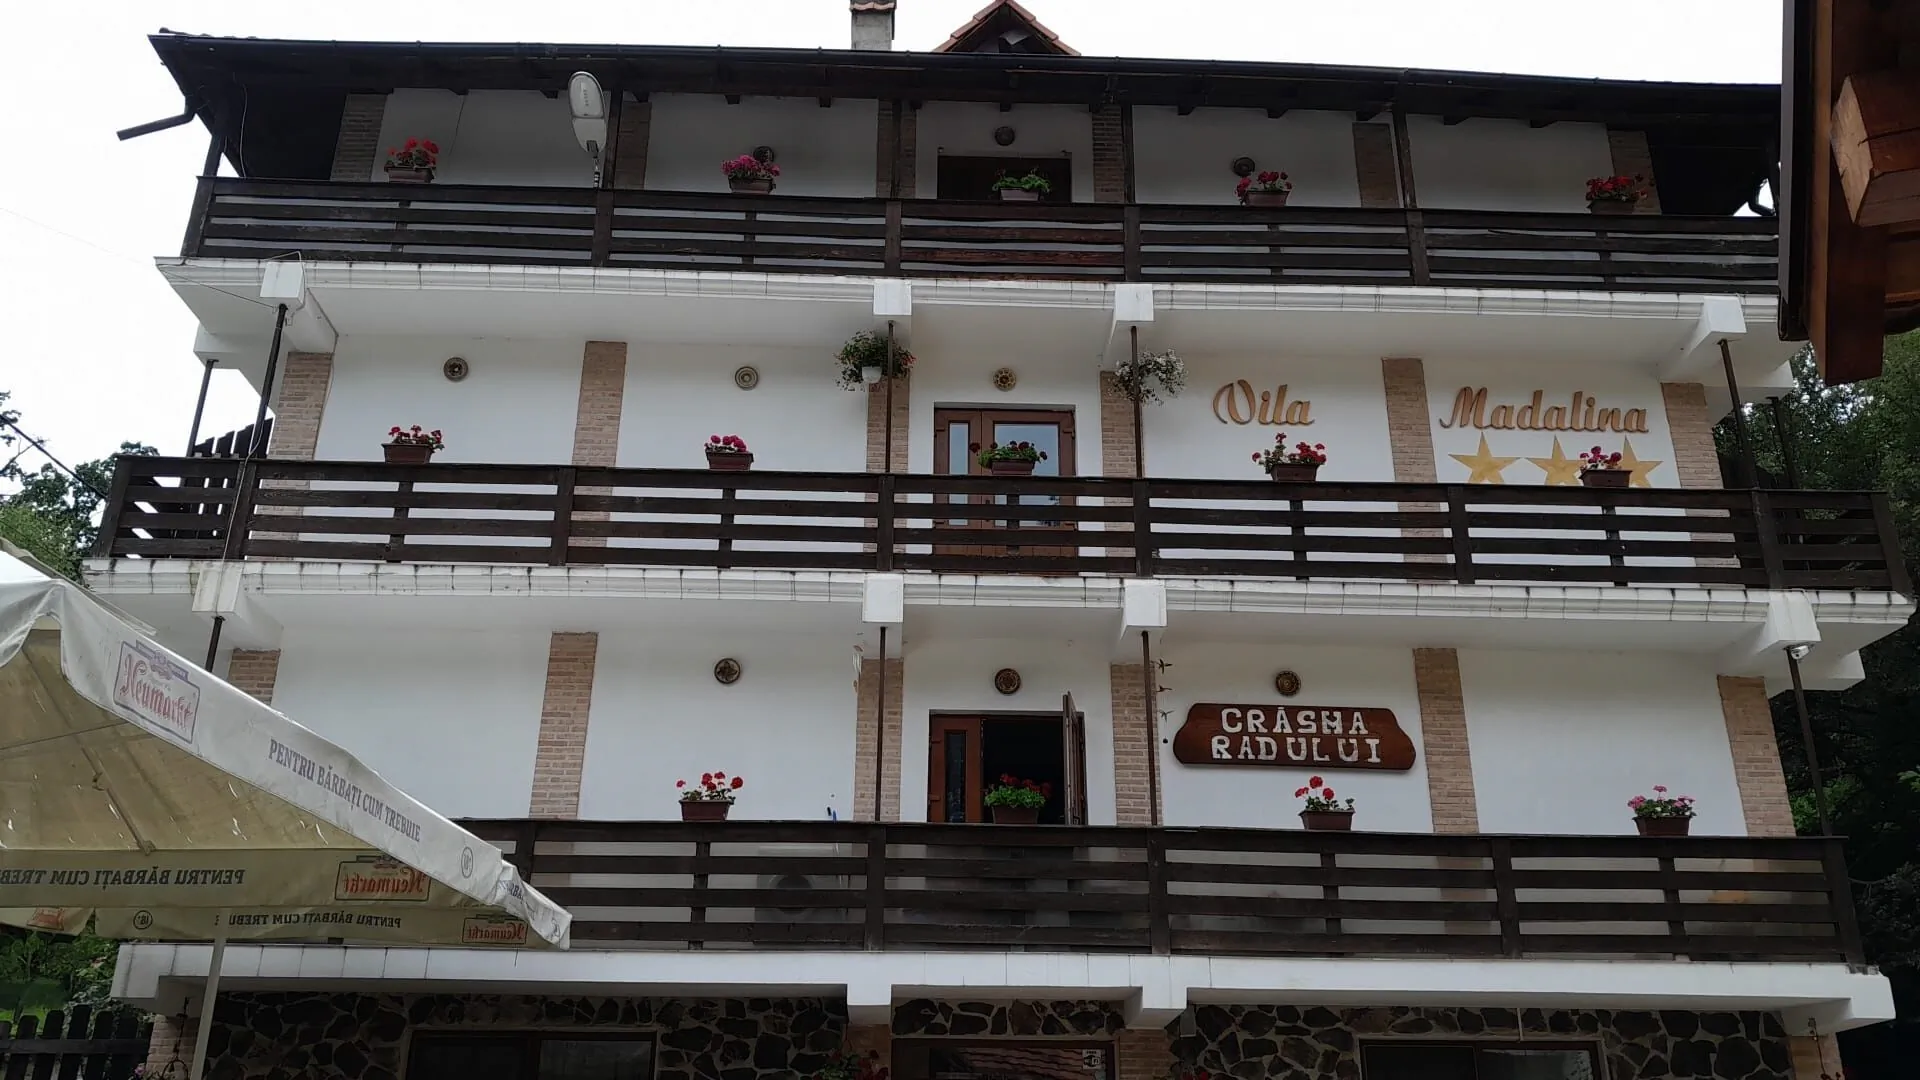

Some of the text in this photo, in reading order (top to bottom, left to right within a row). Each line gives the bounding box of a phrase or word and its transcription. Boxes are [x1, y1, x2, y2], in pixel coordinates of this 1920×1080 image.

[1212, 379, 1649, 433] Vila Madalina
[268, 738, 316, 782] PENTRU
[362, 793, 384, 820] CUM
[384, 805, 421, 843] TREBUIE
